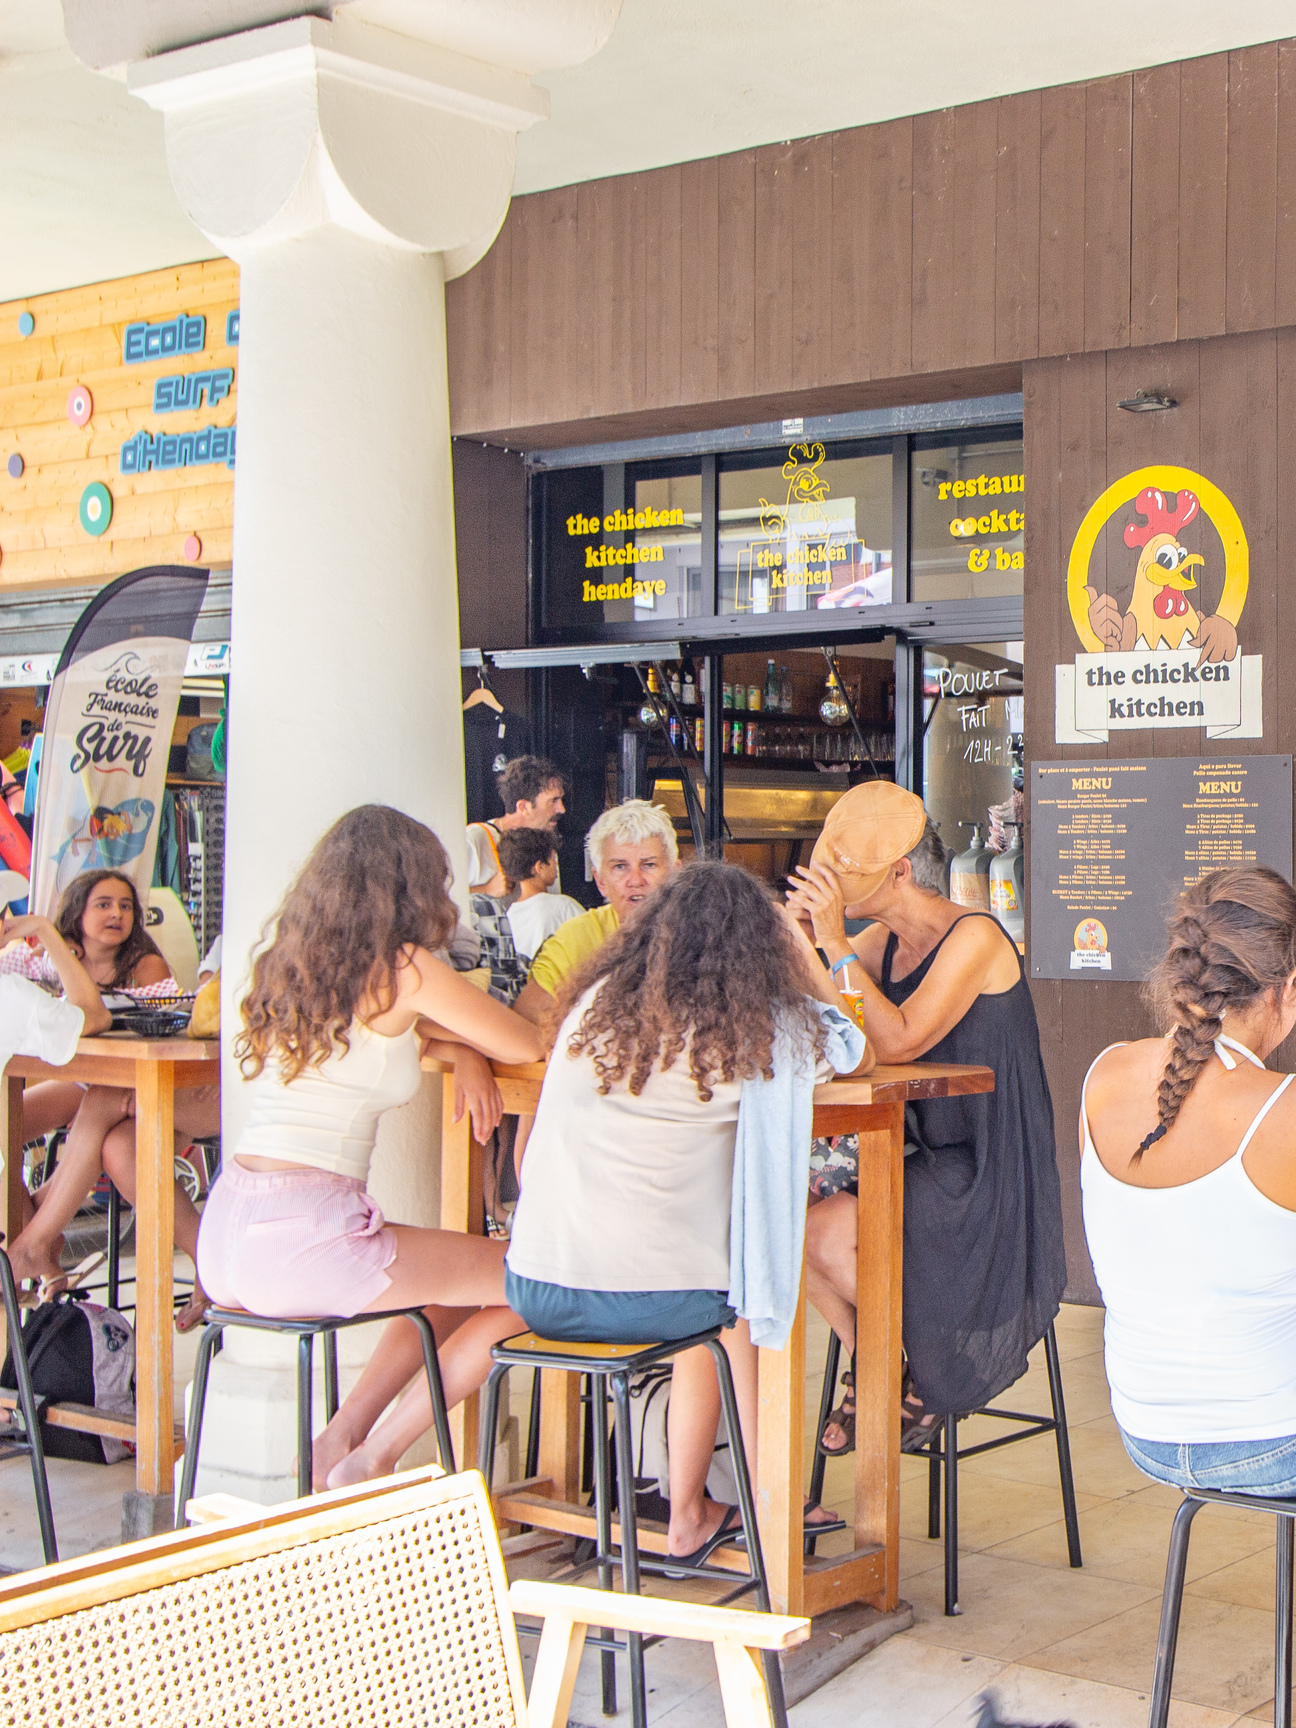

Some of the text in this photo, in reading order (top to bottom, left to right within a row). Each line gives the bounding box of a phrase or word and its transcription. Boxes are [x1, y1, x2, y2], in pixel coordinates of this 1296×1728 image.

[124, 313, 205, 364] Ecole
[120, 424, 236, 474] d'Henda
[566, 506, 684, 535] the chicken
[585, 542, 664, 568] kitchen
[756, 544, 847, 567] the chicken
[967, 548, 990, 572] &
[582, 576, 666, 602] hendaye
[771, 567, 832, 588] kitchen
[105, 669, 158, 699] école
[935, 667, 1008, 698] POULET
[1085, 662, 1230, 686] the chicken
[86, 692, 159, 719] Française
[1109, 696, 1204, 719] kitchen
[107, 718, 123, 733] de
[70, 721, 153, 778] Surf
[1072, 777, 1112, 790] MENU
[1199, 781, 1242, 794] MENU
